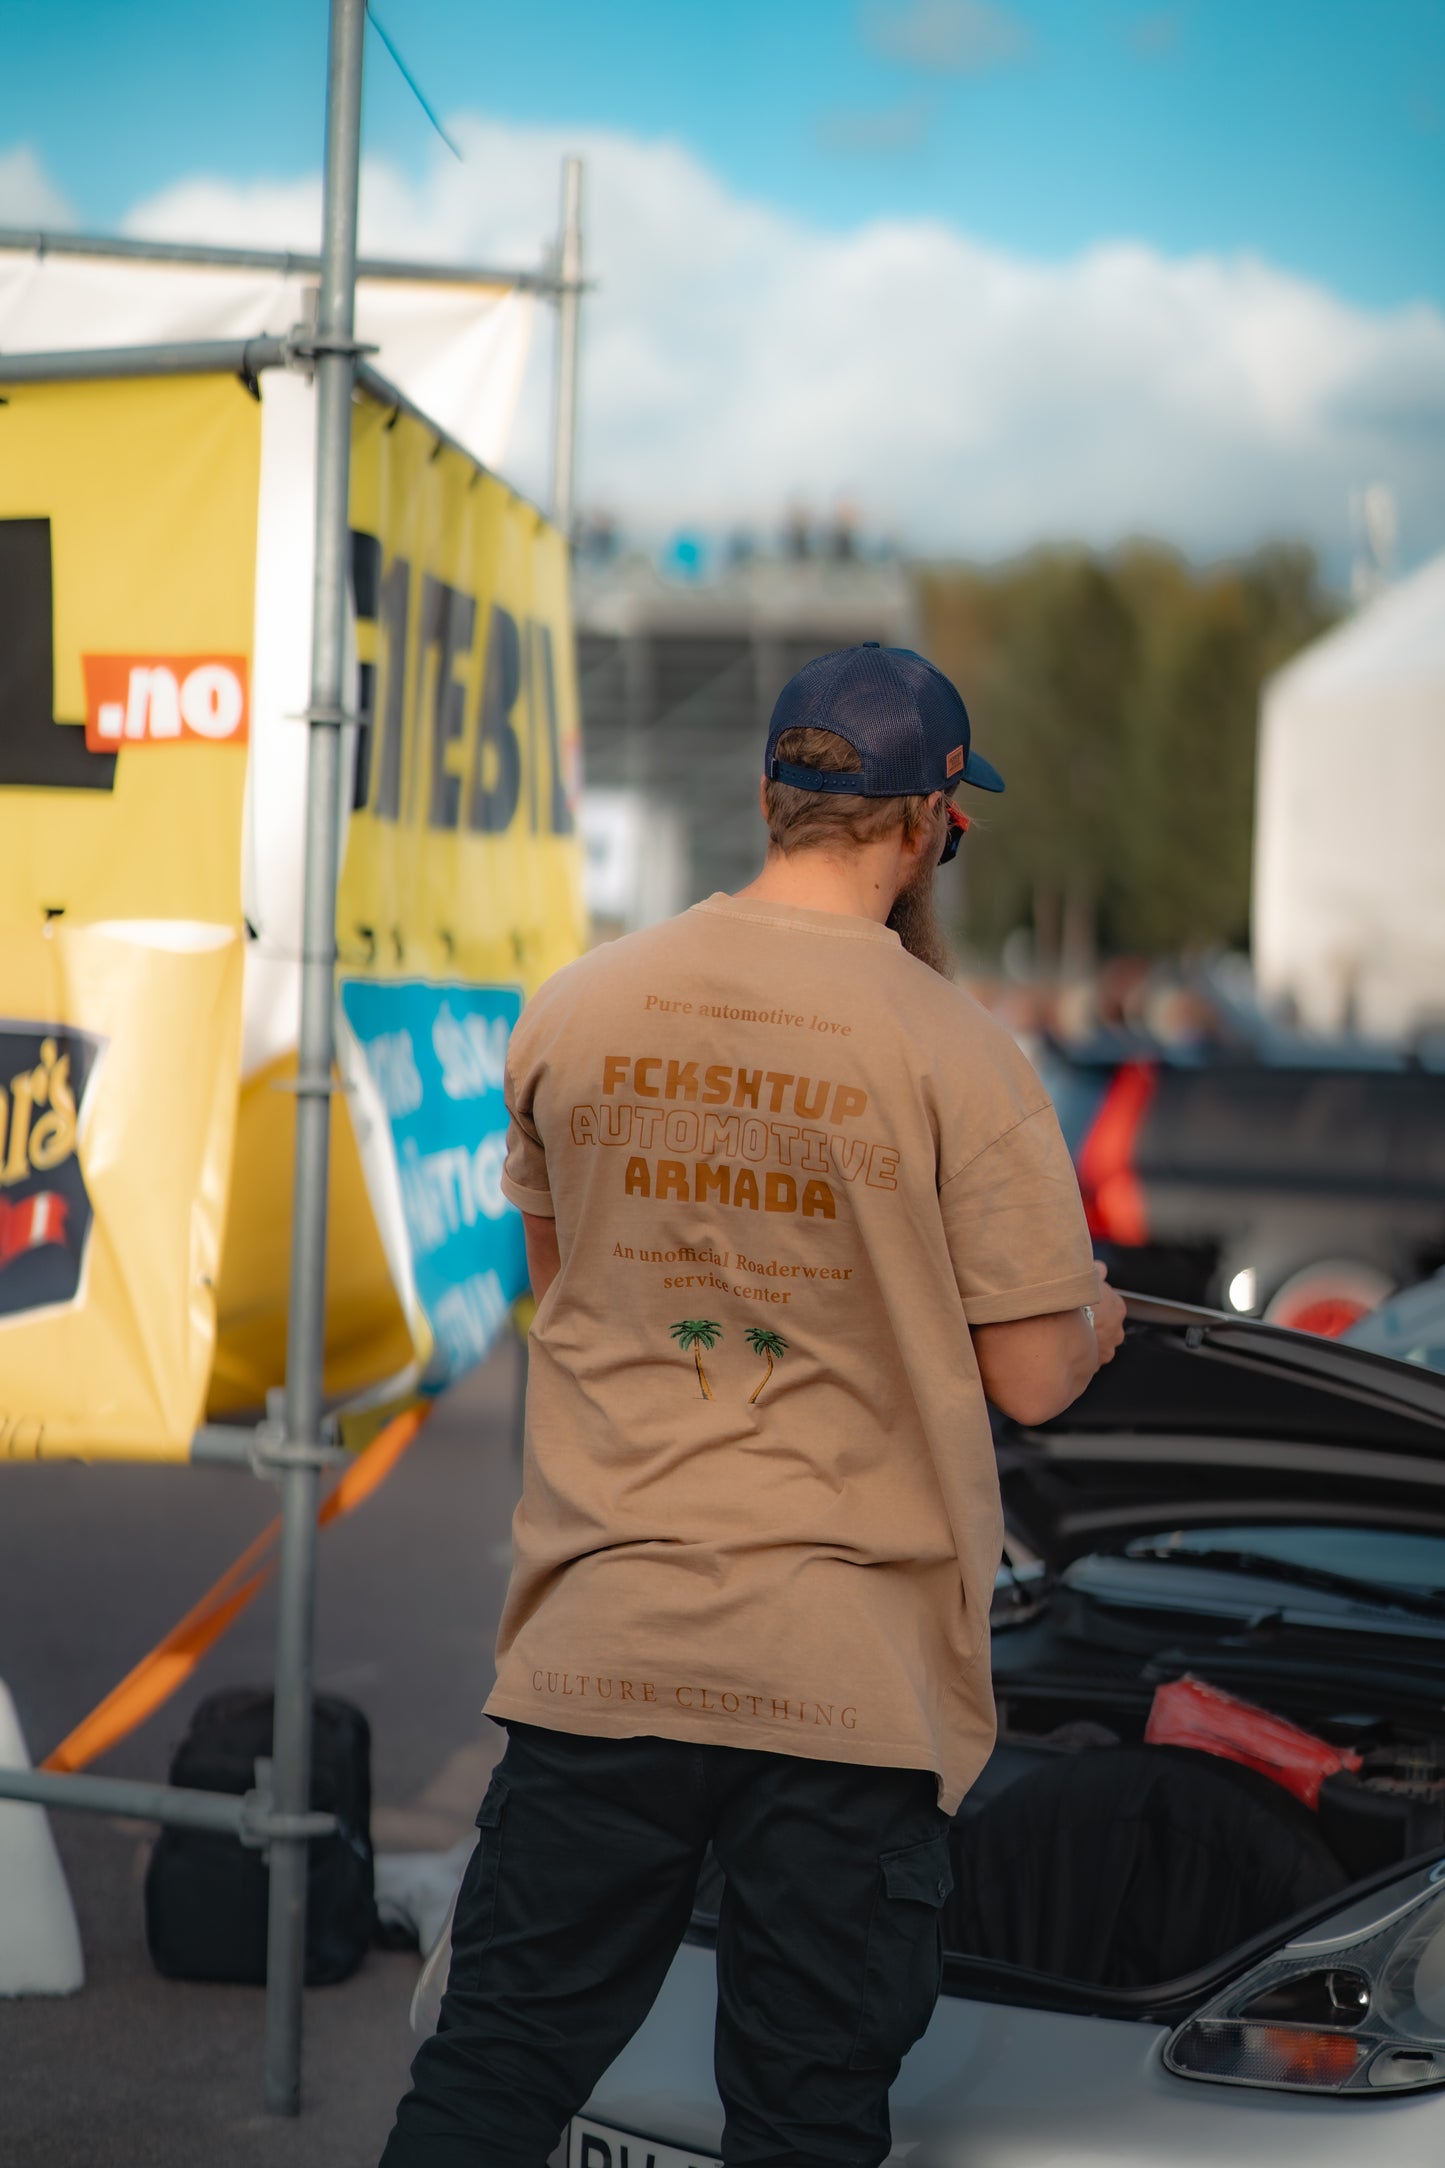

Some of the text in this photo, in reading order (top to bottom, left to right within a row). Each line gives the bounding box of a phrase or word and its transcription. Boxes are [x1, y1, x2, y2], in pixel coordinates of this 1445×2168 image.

[98, 664, 244, 738] .no
[643, 995, 853, 1037] Pure automotive love
[602, 1055, 868, 1126] FCKSHTUP
[571, 1104, 901, 1191] AUTOMOTIVE
[625, 1156, 837, 1220] ARMADA
[612, 1242, 853, 1281] An unofficial Roaderwear
[663, 1272, 792, 1304] service center
[532, 1670, 858, 1730] CULTURE CLOTHING
